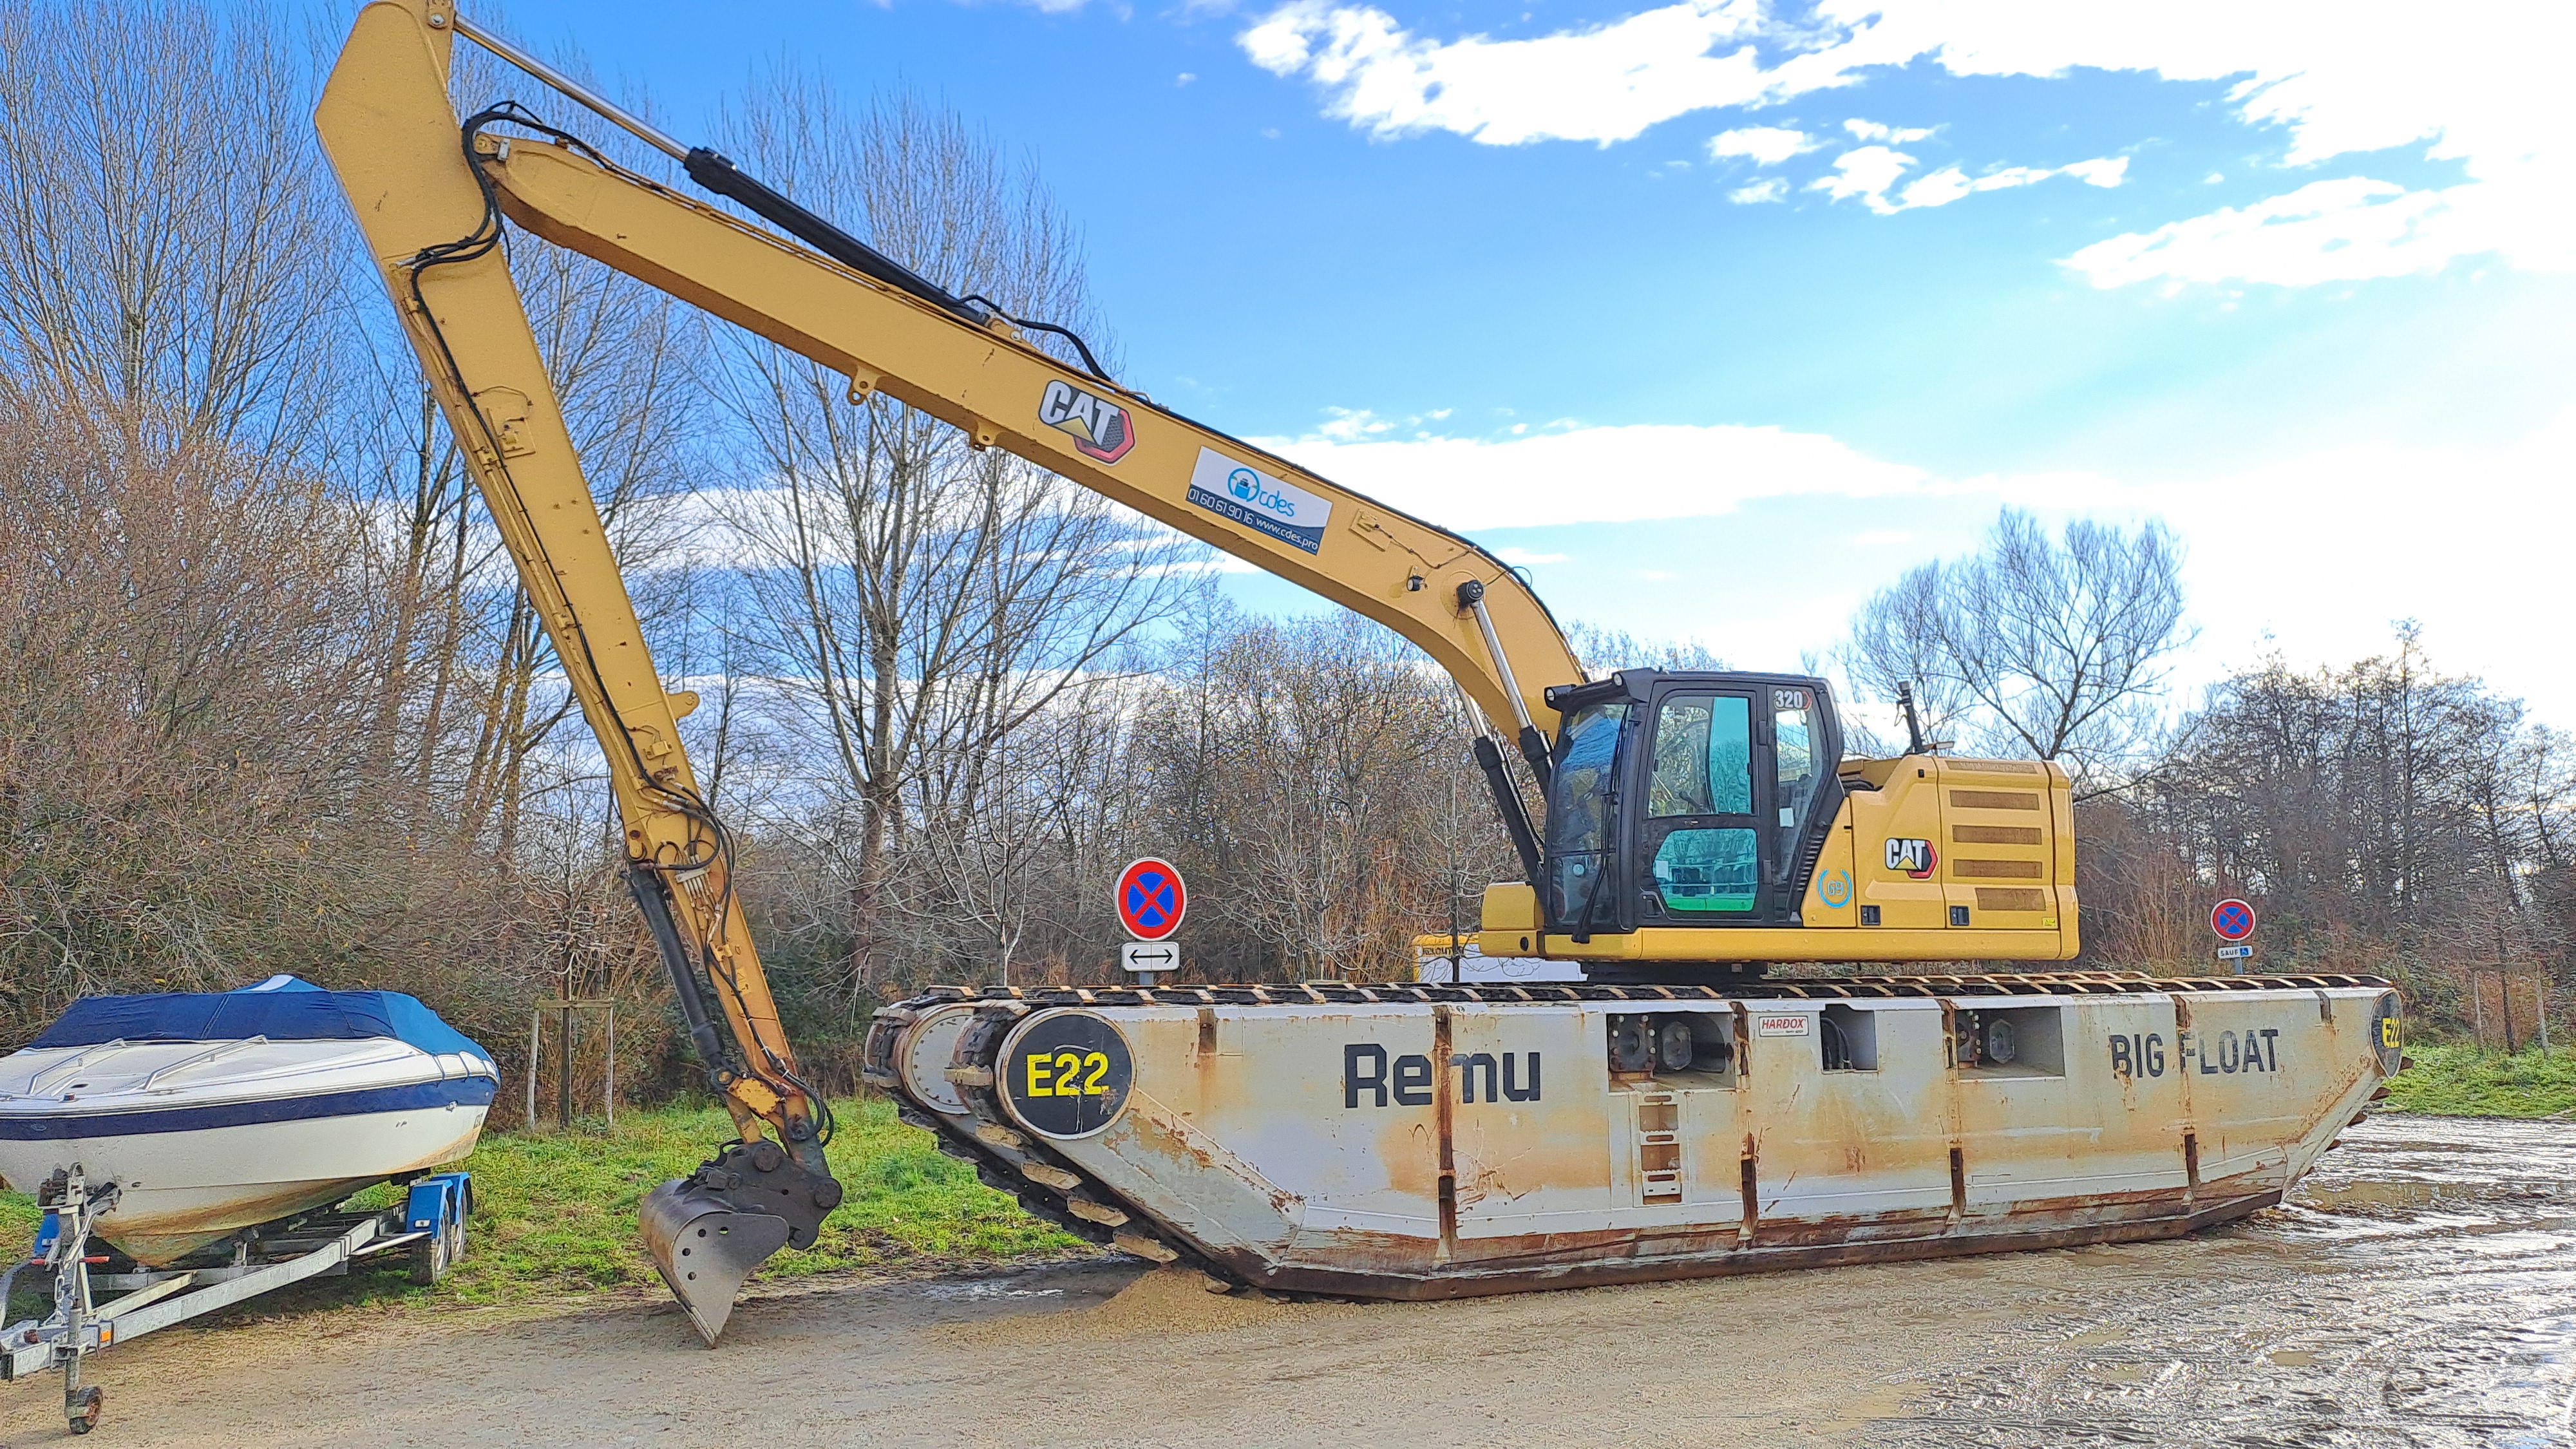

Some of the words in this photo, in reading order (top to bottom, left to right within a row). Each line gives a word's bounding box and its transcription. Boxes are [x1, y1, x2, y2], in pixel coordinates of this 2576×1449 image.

[1040, 381, 1120, 446] CAT
[1188, 488, 1198, 501] 01
[1200, 493, 1215, 508] 60
[1215, 500, 1227, 513] 61
[1227, 505, 1242, 520] 90
[1243, 511, 1255, 524] 16
[1255, 518, 1318, 550] www.cdes.pro
[1258, 490, 1295, 517] cdes
[1776, 690, 1803, 708] 320
[1886, 838, 1926, 870] CAT
[1761, 1019, 1804, 1029] HARDOX
[2382, 1017, 2400, 1048] E22
[2109, 1033, 2164, 1079] BIG
[2179, 1028, 2279, 1075] FLOAT
[1027, 1052, 1110, 1097] E22
[1345, 1043, 1540, 1108] Remu
